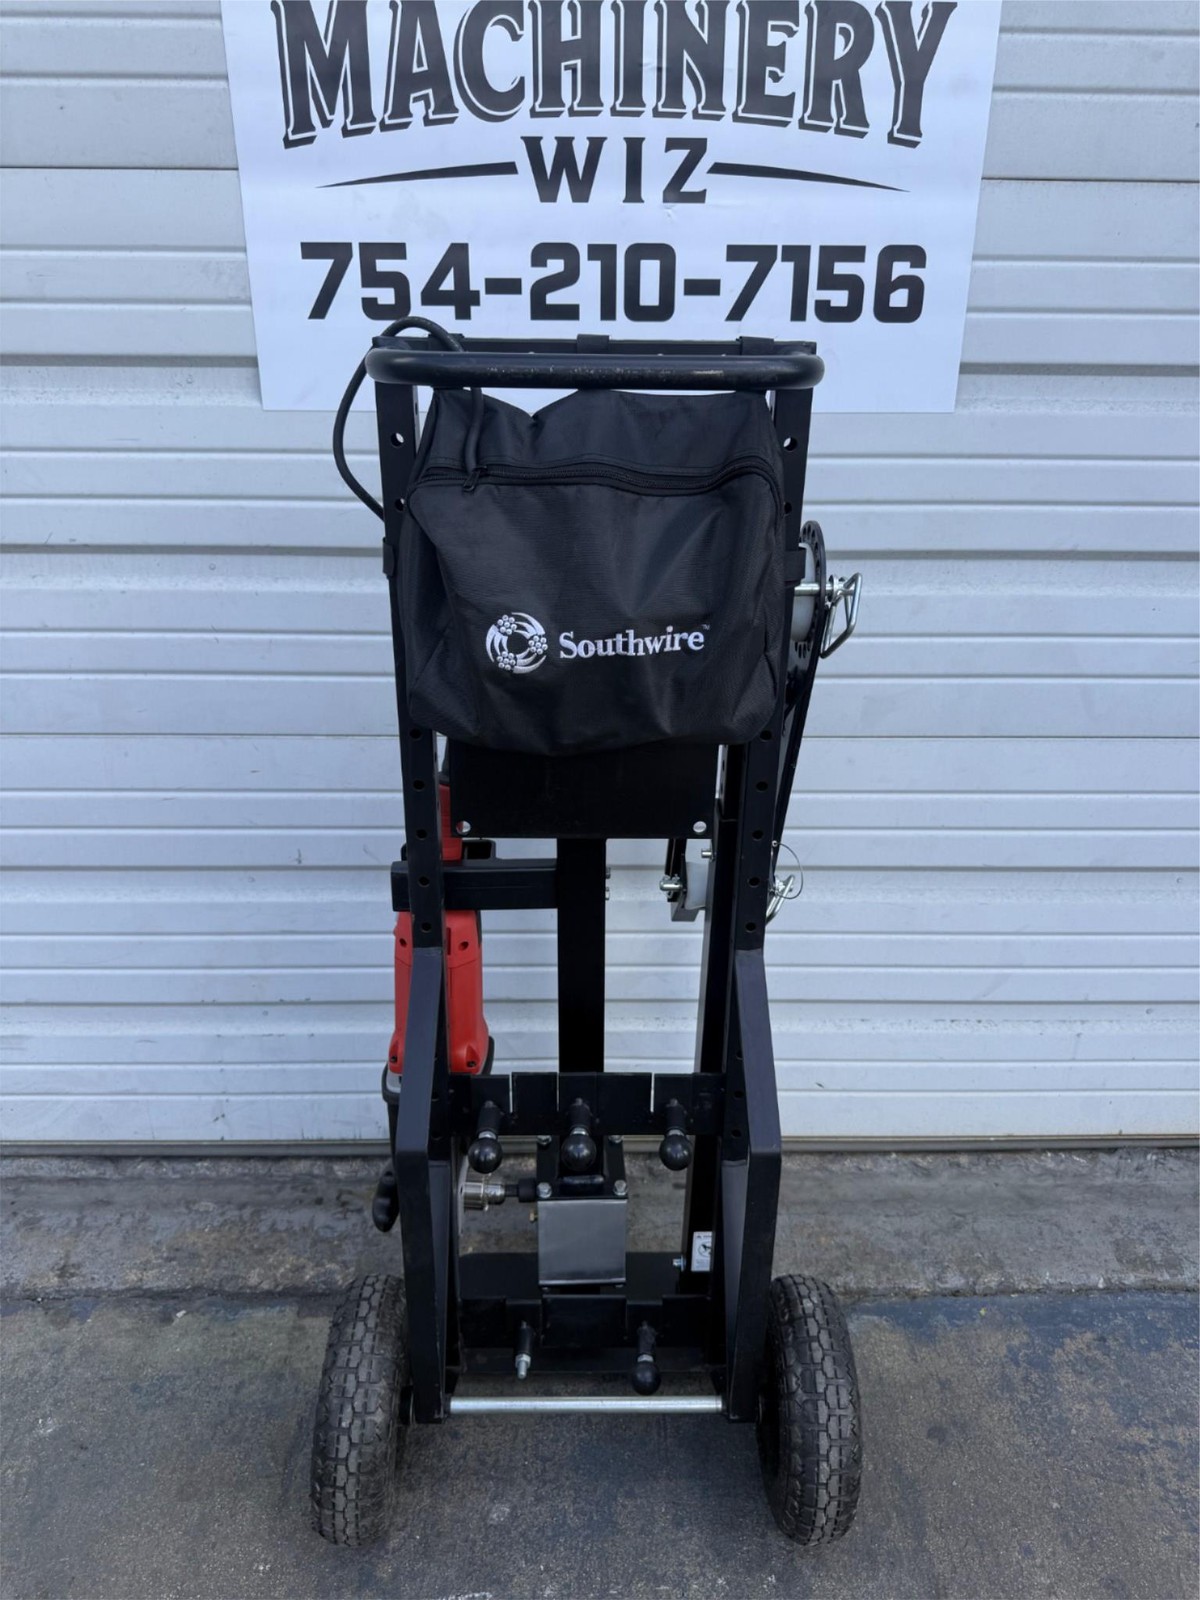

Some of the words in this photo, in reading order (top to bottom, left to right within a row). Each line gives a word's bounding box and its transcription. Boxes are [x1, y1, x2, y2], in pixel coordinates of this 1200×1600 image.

[270, 0, 957, 149] MACHINERY
[520, 136, 708, 204] WIZ
[300, 241, 927, 324] 754-210-7156
[558, 625, 705, 659] Southwire
